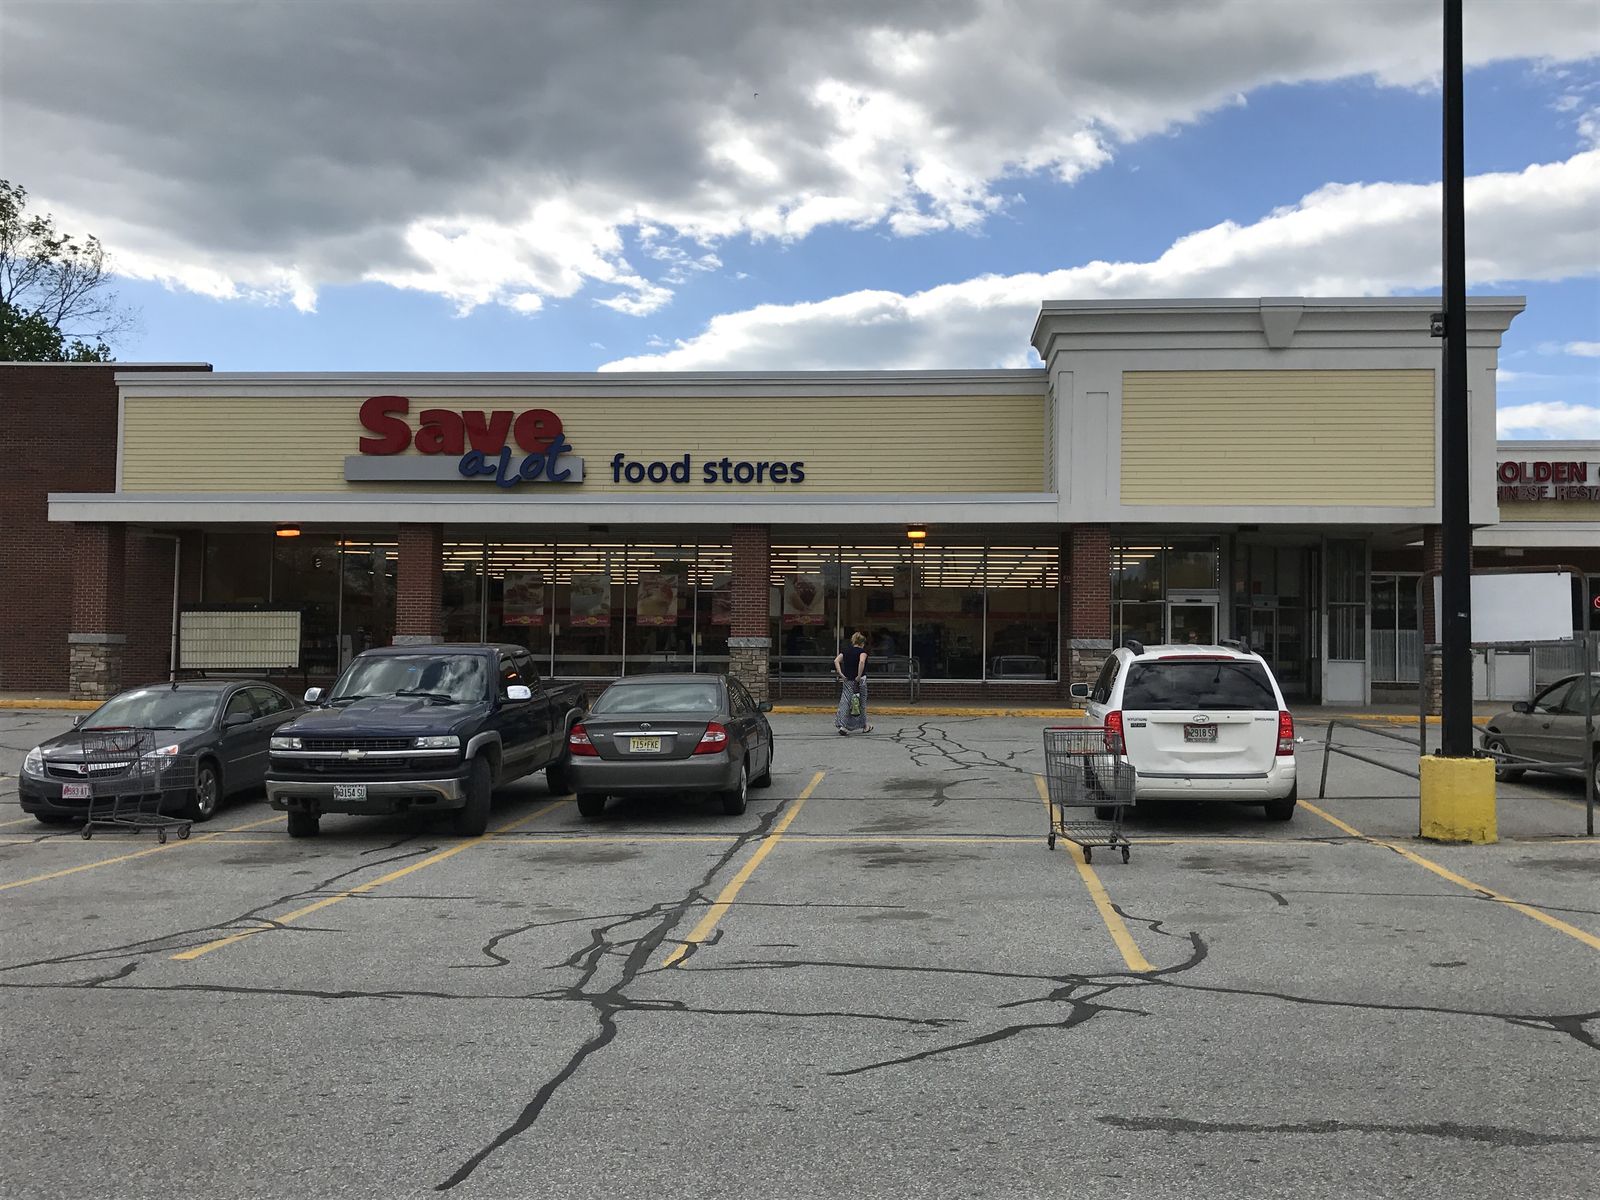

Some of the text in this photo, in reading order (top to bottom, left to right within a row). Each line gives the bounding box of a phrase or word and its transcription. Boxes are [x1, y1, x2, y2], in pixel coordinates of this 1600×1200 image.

[359, 395, 564, 456] Save
[611, 453, 806, 485] food stores
[1497, 461, 1587, 484] OLDEN
[1497, 485, 1549, 501] INESE
